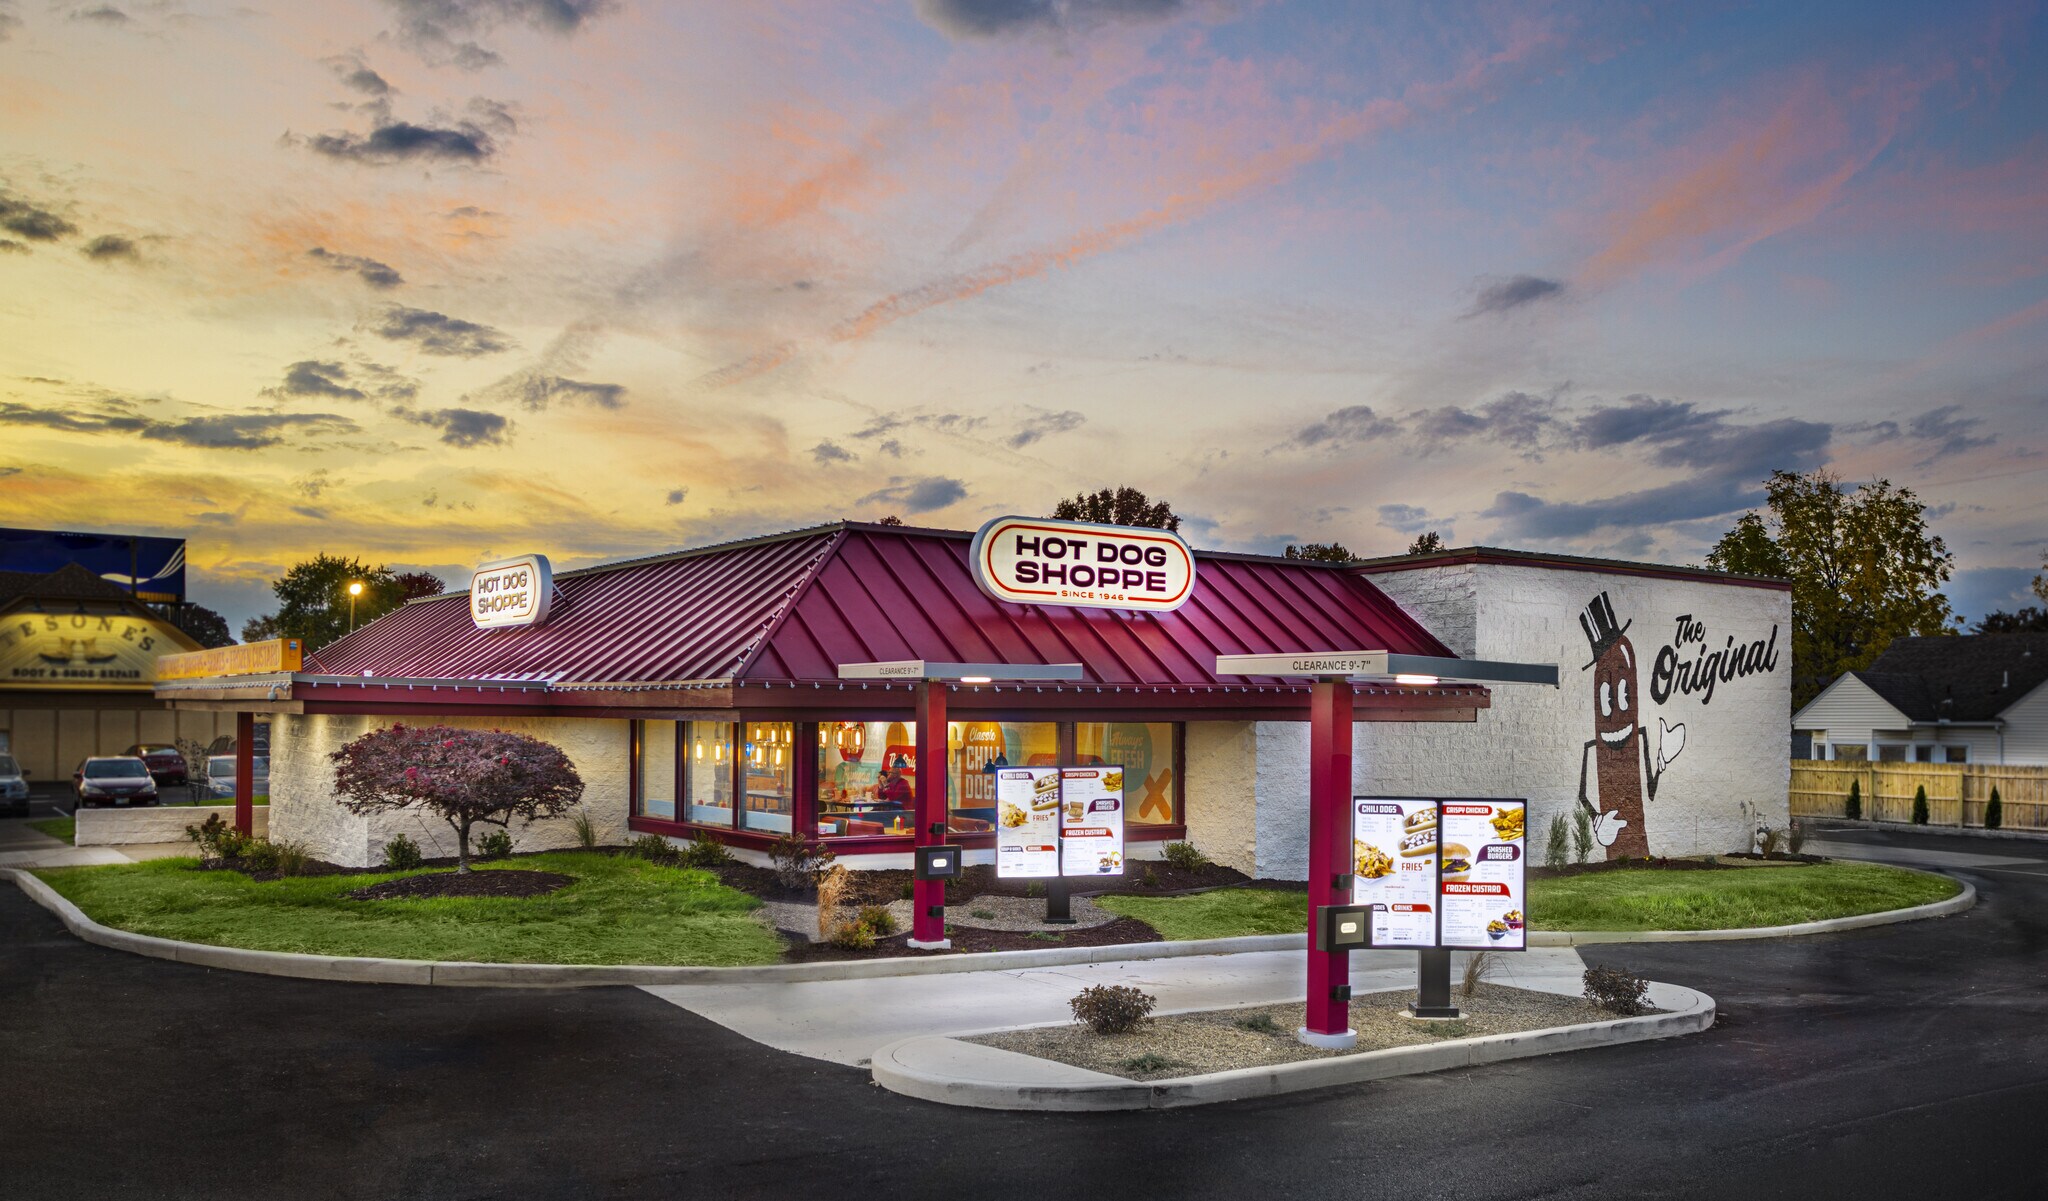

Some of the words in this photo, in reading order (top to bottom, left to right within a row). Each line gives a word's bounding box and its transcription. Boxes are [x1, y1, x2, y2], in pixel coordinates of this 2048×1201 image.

[1015, 535, 1088, 560] HOT
[1096, 542, 1167, 567] DOG
[478, 575, 500, 594] HOT
[502, 570, 527, 590] DOG
[1015, 560, 1167, 592] SHOPPE
[478, 591, 527, 614] SHOPPE
[1061, 590, 1095, 599] SINCE
[1099, 593, 1124, 601] 1946
[0, 614, 155, 651] TESONE'S
[1674, 613, 1706, 650] The
[253, 643, 280, 669] CUSTARD
[1292, 660, 1347, 671] CLEARANCE
[1650, 624, 1779, 705] Original
[12, 668, 45, 678] BOOT
[100, 668, 141, 678] REPAIR
[879, 667, 907, 675] CLEARANCE
[969, 727, 996, 742] Classic
[1111, 731, 1145, 750] Always
[1110, 749, 1145, 769] FRESH
[965, 774, 996, 800] DOG
[1361, 805, 1379, 813] CHILI
[1380, 805, 1397, 814] DOGS
[1487, 852, 1513, 860] BURGERS
[1401, 863, 1423, 871] FRIES
[1446, 884, 1471, 893] FROZEN
[1472, 885, 1501, 893] CUSTARD
